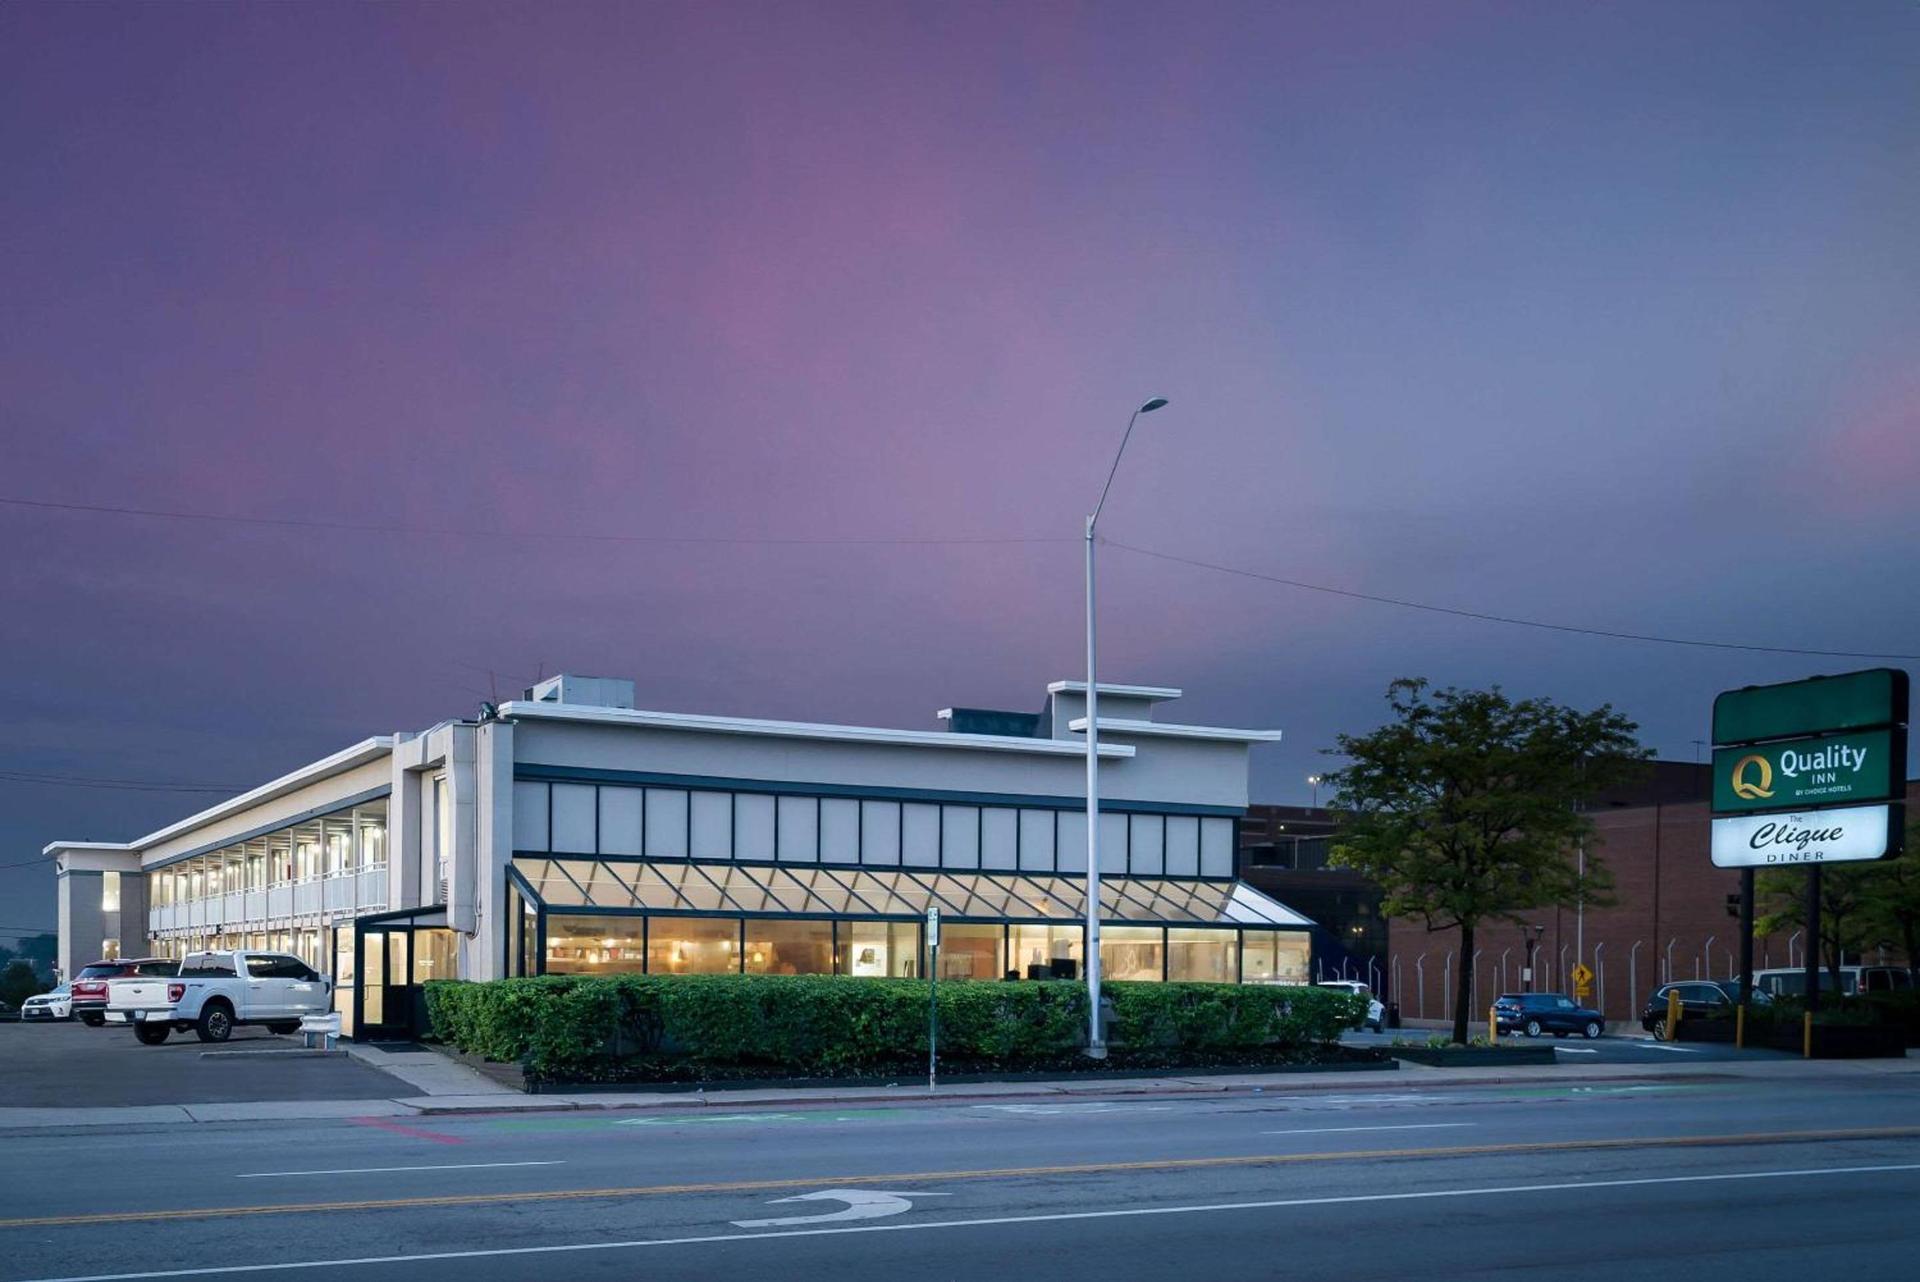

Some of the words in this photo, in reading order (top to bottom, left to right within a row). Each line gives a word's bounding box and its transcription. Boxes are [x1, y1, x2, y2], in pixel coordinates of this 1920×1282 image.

[1780, 745, 1867, 777] Quality
[1732, 755, 1776, 799] Q
[1811, 772, 1836, 784] INN
[1804, 787, 1827, 795] CHOICE
[1828, 784, 1852, 793] HOTELS
[1789, 815, 1803, 823] The
[1749, 822, 1844, 851] Clique
[1767, 851, 1824, 862] DINER
